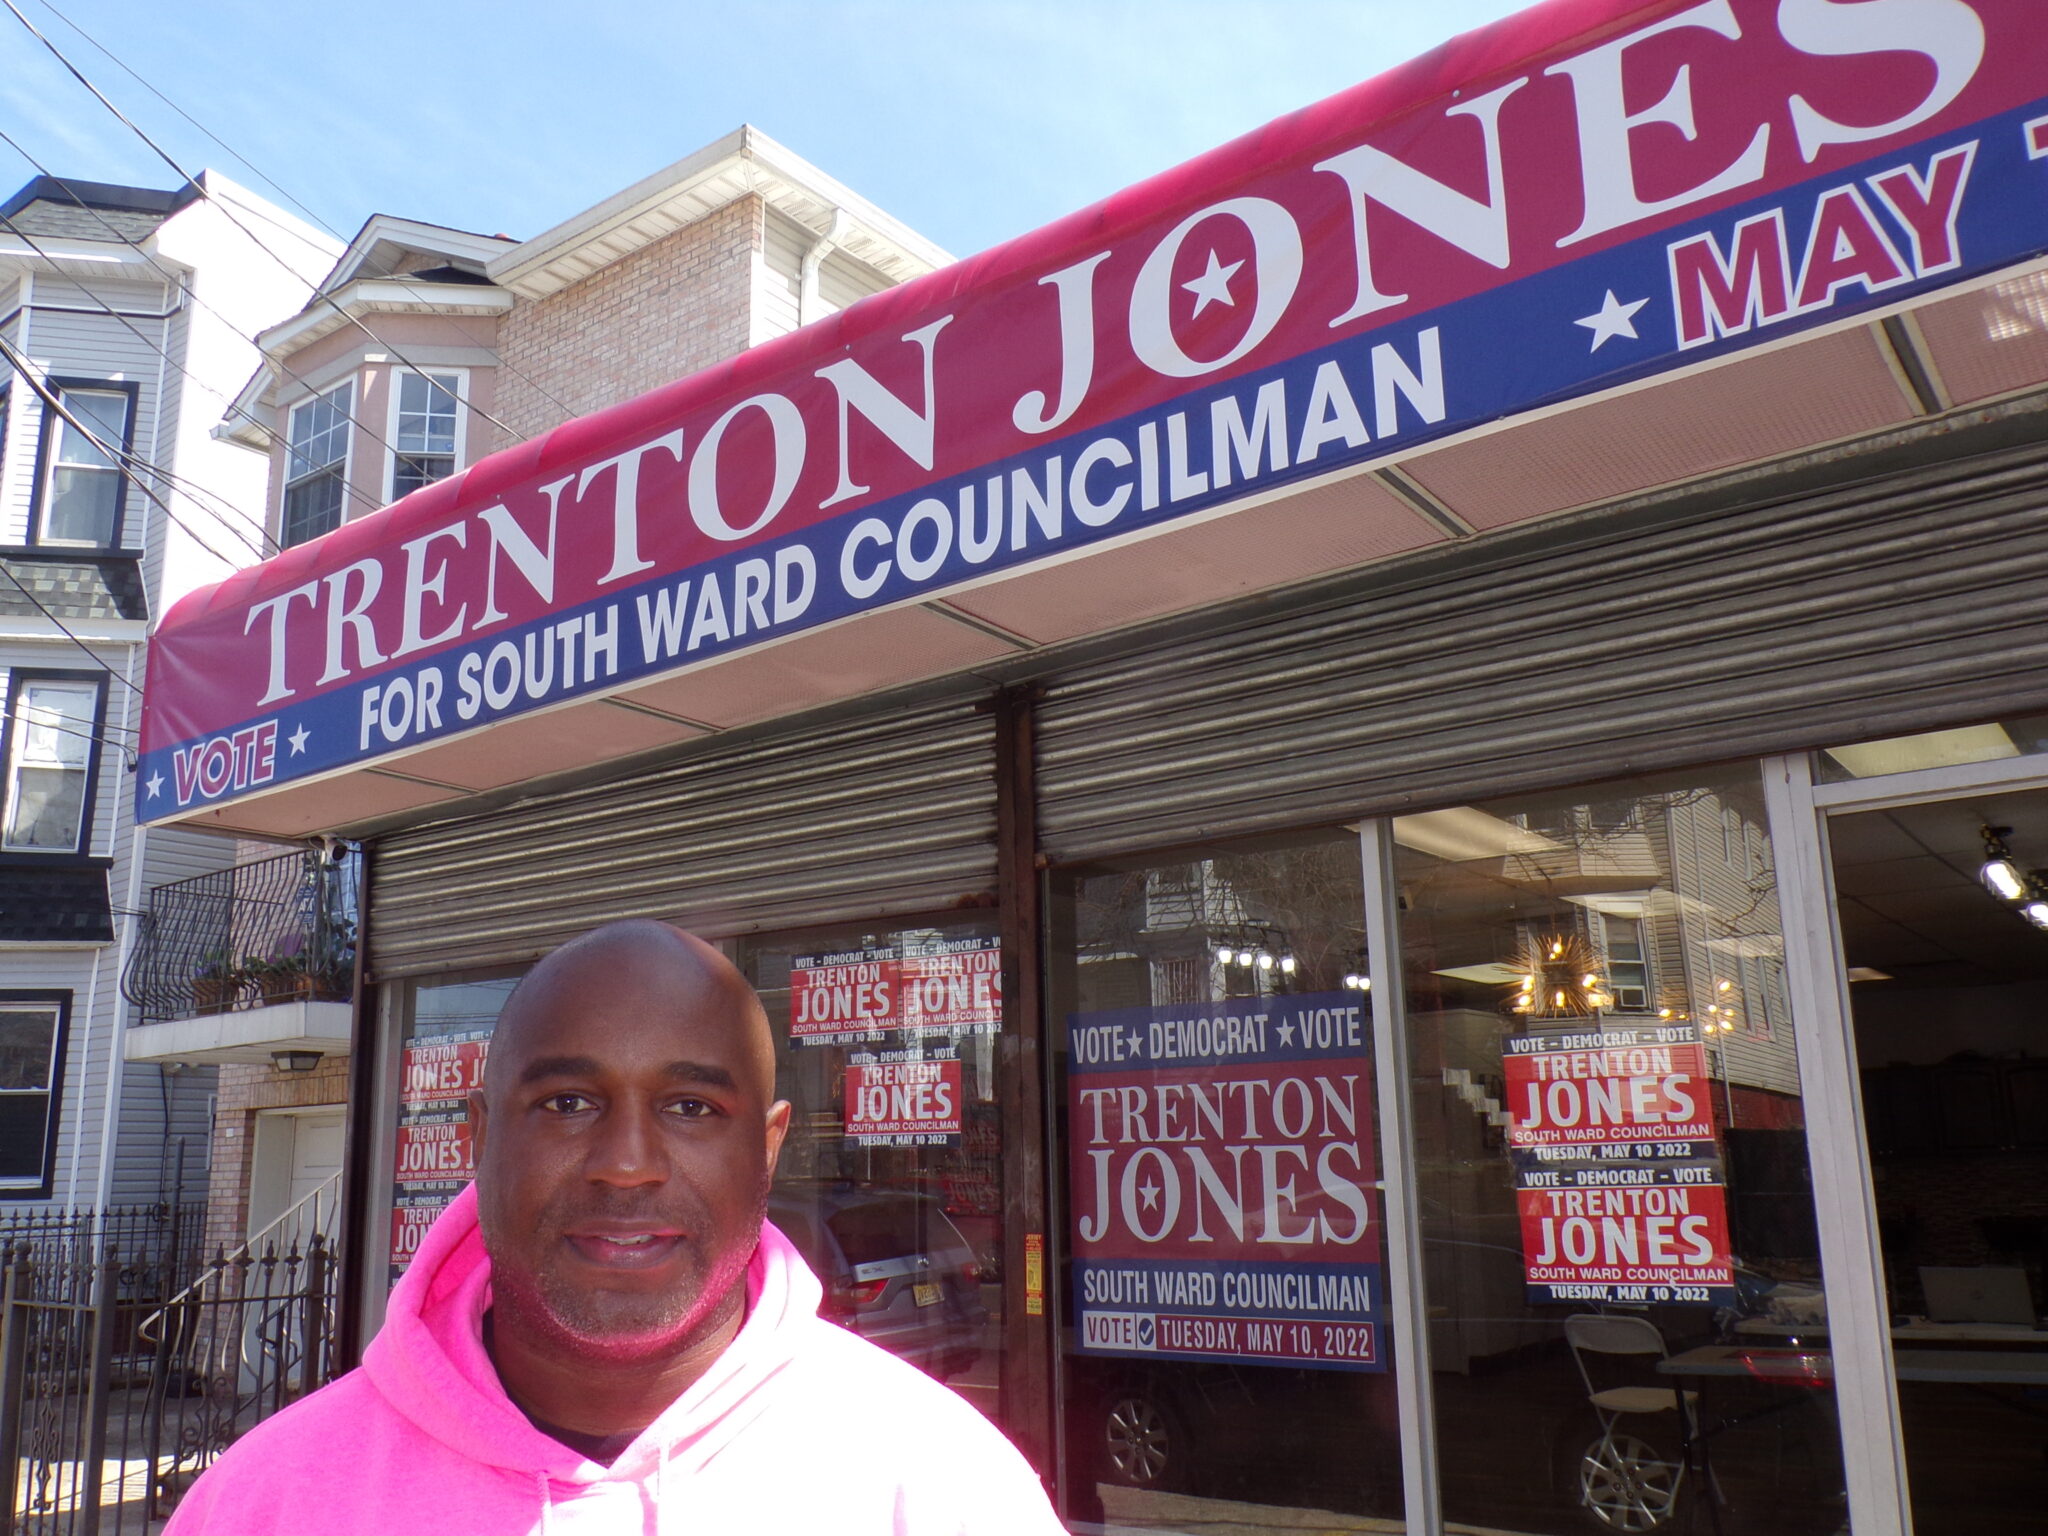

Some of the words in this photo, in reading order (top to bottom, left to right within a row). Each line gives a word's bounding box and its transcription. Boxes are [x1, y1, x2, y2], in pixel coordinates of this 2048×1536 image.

[243, 313, 954, 706] TRENTON
[1012, 0, 1986, 434] JONES
[173, 719, 278, 805] VOTE
[360, 667, 443, 750] FOR
[457, 603, 619, 719] SOUTH
[637, 545, 816, 663] WARD
[840, 326, 1446, 599] COUNCILMAN
[1667, 139, 1979, 350] MAY
[905, 945, 926, 956] VOTE
[936, 938, 982, 953] DEMOCRAT
[796, 957, 814, 968] VOTE
[823, 952, 864, 965] DEMOCRAT
[873, 948, 893, 960] VOTE
[918, 951, 1000, 977] TRENTON
[807, 964, 880, 988] TRENTON
[797, 982, 890, 1023] JONES
[792, 1024, 817, 1033] SOUTH
[820, 1022, 841, 1031] WARD
[843, 1018, 896, 1029] COUNCILMAN
[904, 1015, 930, 1024] SOUTH
[933, 1013, 957, 1022] WARD
[960, 1010, 1002, 1020] COUNCIL
[454, 1033, 466, 1041] VOTE
[470, 1031, 484, 1040] VOTE
[802, 1035, 835, 1046] TUESDAY,
[837, 1034, 854, 1043] MAY
[856, 1033, 864, 1042] 10
[867, 1031, 885, 1041] 2022
[953, 1026, 971, 1036] MAY
[974, 1025, 983, 1034] 10
[987, 1023, 1001, 1033] 202
[1072, 1025, 1124, 1064] VOTE
[1149, 1014, 1268, 1059] DEMOCRAT
[1298, 1007, 1361, 1049] VOTE
[1510, 1036, 1545, 1053] VOTE
[1562, 1030, 1639, 1050] DEMOCRAT
[1656, 1026, 1694, 1042] VOTE
[410, 1045, 458, 1064] TRENTON
[850, 1053, 872, 1064] VOTE
[880, 1050, 923, 1062] DEMOCRAT
[934, 1047, 956, 1058] VOTE
[1533, 1048, 1672, 1081] TRENTON
[404, 1060, 463, 1092] JONES
[862, 1063, 942, 1086] TRENTON
[432, 1088, 466, 1098] COUNCILMAN
[852, 1082, 952, 1121] JONES
[1521, 1073, 1695, 1129] JONES
[452, 1112, 466, 1122] VOTE
[1079, 1075, 1360, 1144] TRENTON
[408, 1125, 456, 1143] TRENTON
[848, 1123, 874, 1132] SOUTH
[876, 1122, 900, 1131] WARD
[902, 1120, 959, 1131] COUNCILMAN
[1514, 1130, 1560, 1143] SOUTH
[1564, 1128, 1605, 1141] WARD
[1610, 1124, 1709, 1139] COUNCILMAN
[858, 1136, 893, 1147] TUESDAY,
[896, 1135, 913, 1146] MAY
[916, 1135, 925, 1144] 10
[928, 1135, 947, 1144] 2022
[400, 1140, 461, 1171] JONES
[1534, 1145, 1596, 1162] TUESDAY,
[1601, 1144, 1631, 1158] MAY
[1635, 1144, 1651, 1157] 10
[1657, 1142, 1691, 1157] 2022
[430, 1170, 464, 1178] COUNCILMAN
[1524, 1171, 1560, 1187] VOTE
[1577, 1169, 1655, 1186] DEMOCRAT
[1673, 1167, 1712, 1183] VOTE
[396, 1198, 409, 1206] VOTE
[1078, 1141, 1368, 1245] JONES
[1547, 1188, 1689, 1217] TRENTON
[1536, 1215, 1713, 1265] JONES
[1530, 1267, 1575, 1280] SOUTH
[1580, 1267, 1622, 1280] WARD
[1626, 1268, 1728, 1281] COUNCILMAN
[1084, 1269, 1148, 1304] SOUTH
[1154, 1271, 1216, 1307] WARD
[1222, 1272, 1370, 1312] COUNCILMAN
[1550, 1285, 1612, 1302] TUESDAY,
[1617, 1285, 1647, 1300] MAY
[1652, 1286, 1669, 1300] 10
[1674, 1286, 1709, 1301] 2022
[1087, 1316, 1132, 1344] VOTE
[1160, 1319, 1241, 1355] TUESDAY,
[1247, 1323, 1284, 1353] MAY
[1289, 1325, 1318, 1359] 10,
[1324, 1327, 1369, 1358] 2022
